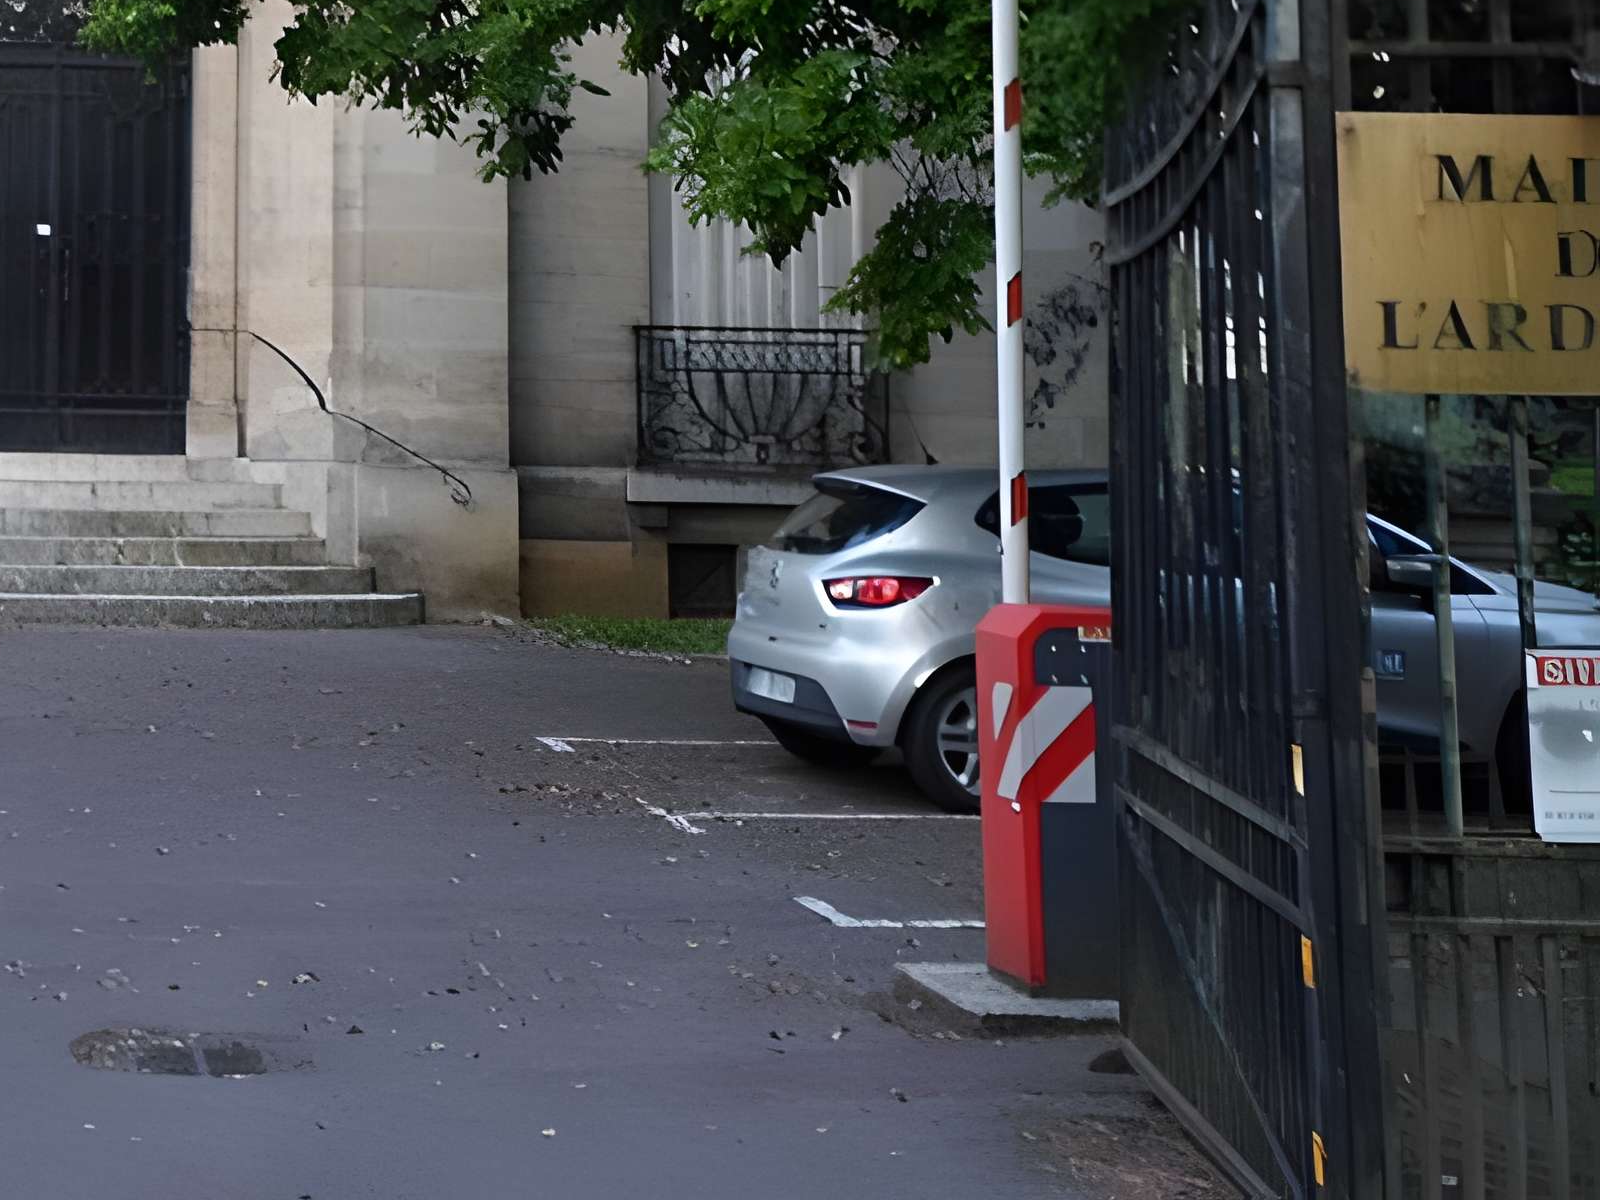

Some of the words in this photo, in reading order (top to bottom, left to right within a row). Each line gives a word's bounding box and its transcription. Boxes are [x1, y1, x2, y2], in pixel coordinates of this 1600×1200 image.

[1433, 153, 1600, 204] MAI
[1554, 229, 1600, 278] D
[1375, 300, 1595, 353] L'ARD
